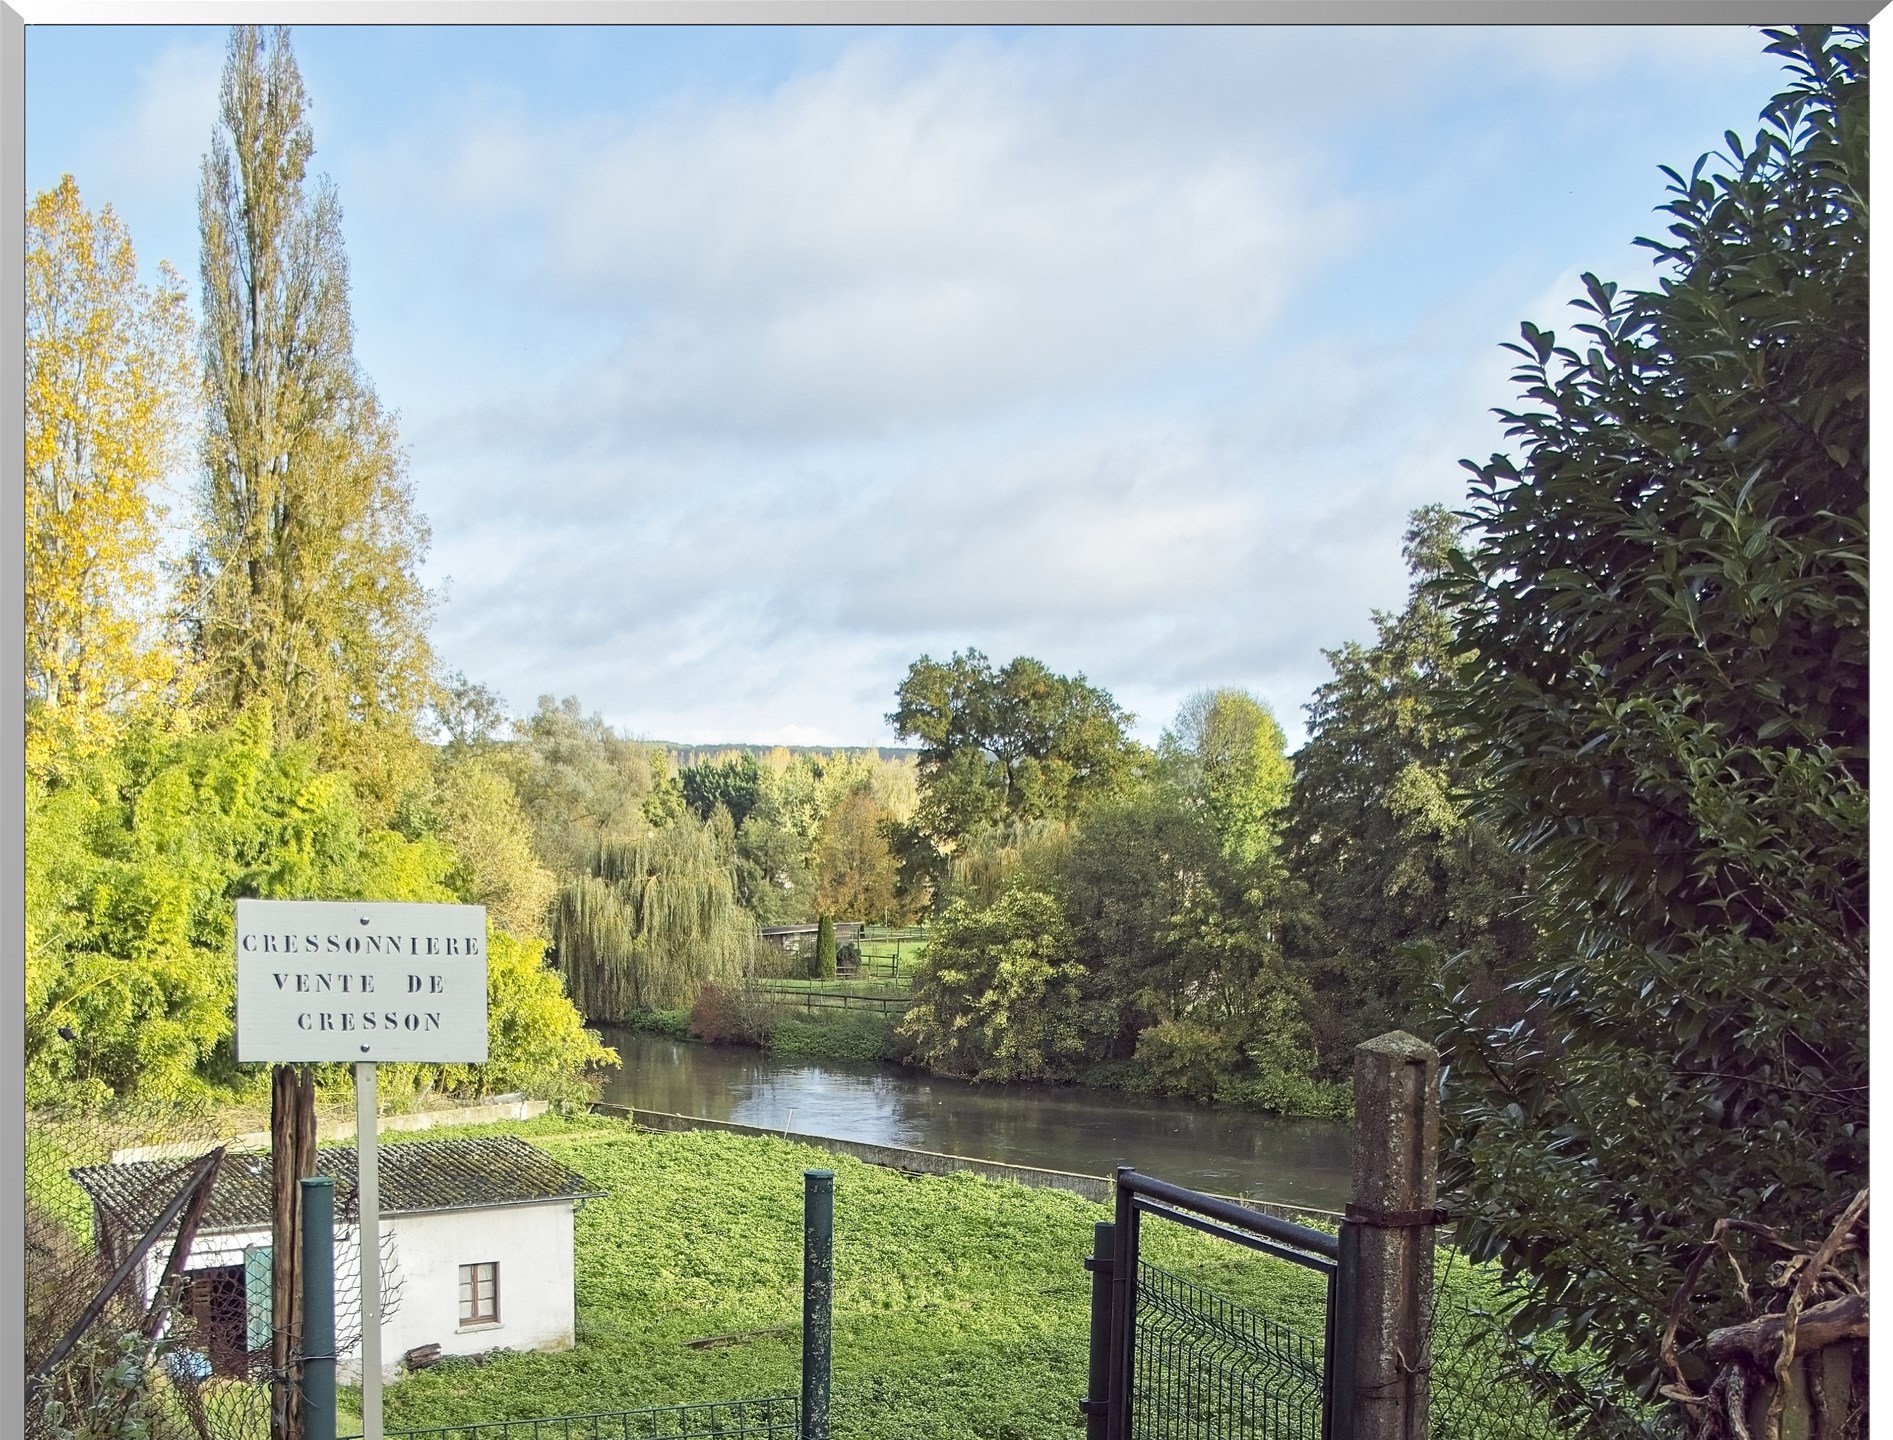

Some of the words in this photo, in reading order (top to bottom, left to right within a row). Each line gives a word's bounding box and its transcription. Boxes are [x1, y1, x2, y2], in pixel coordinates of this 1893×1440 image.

[243, 934, 479, 956] CRESSONNIERE
[273, 973, 375, 993] VENTE
[407, 974, 444, 994] DE
[298, 1012, 441, 1031] CRESSON
